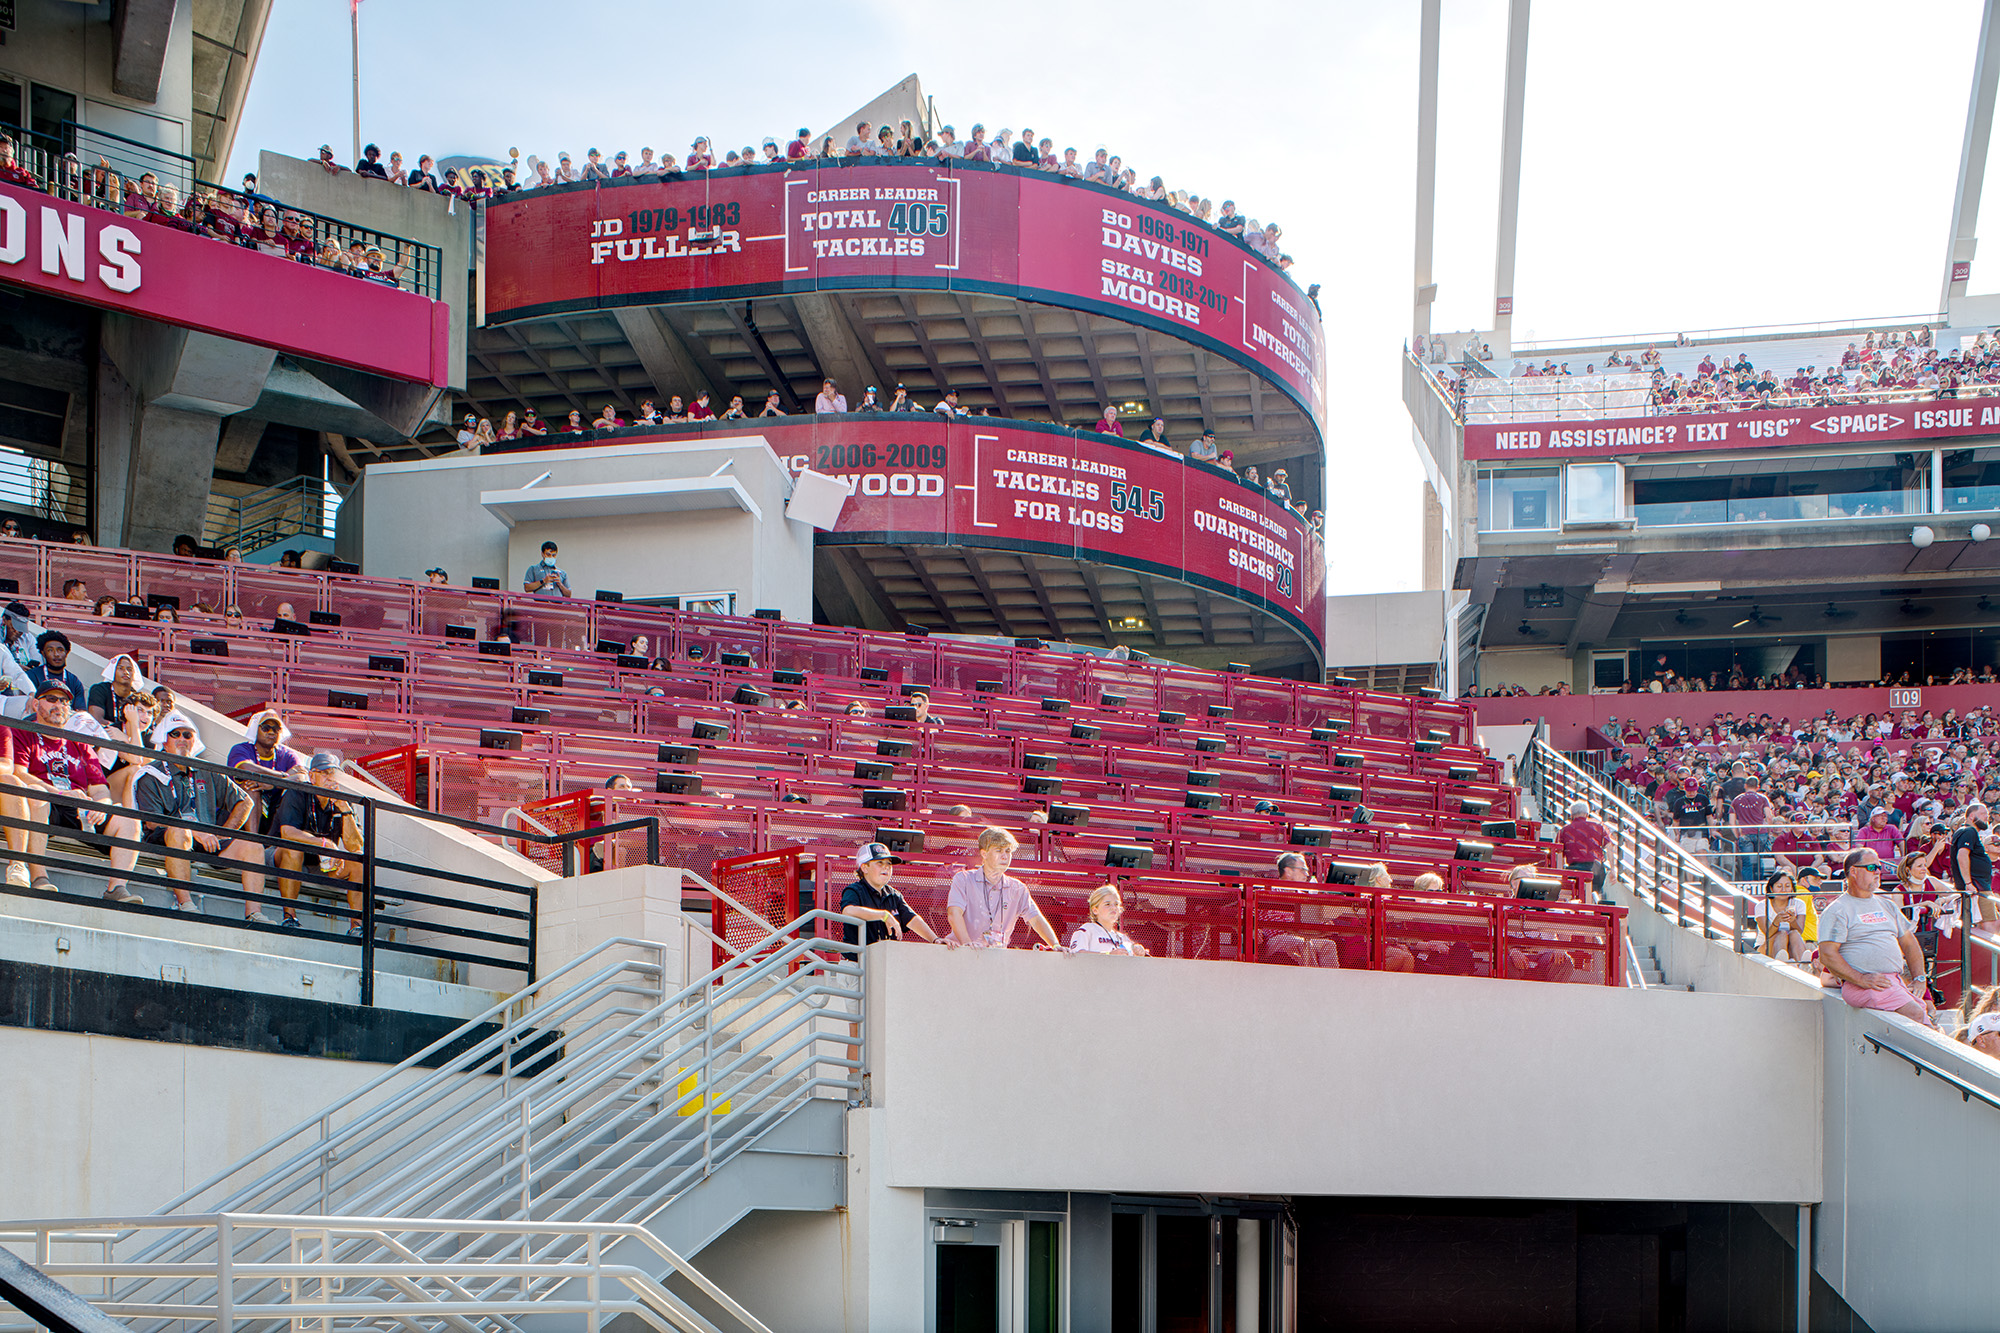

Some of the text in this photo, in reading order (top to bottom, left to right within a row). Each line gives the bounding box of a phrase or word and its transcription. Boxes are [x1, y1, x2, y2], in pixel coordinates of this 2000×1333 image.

[807, 187, 938, 203] CAREER LEADER
[591, 201, 741, 238] JD 1979-1983
[801, 202, 949, 237] TOTAL 405
[1102, 208, 1209, 258] BO 1969-1971
[813, 237, 925, 258] TACKLES
[1102, 226, 1203, 277] DAVIES
[1101, 258, 1228, 315] SKAI 2013-2017
[1101, 276, 1200, 325] MOORE
[1271, 290, 1299, 322] CAREER
[1282, 318, 1312, 361] TOTAL
[1495, 431, 1541, 450] NEED
[1548, 425, 1677, 448] ASSISTANCE?
[1685, 422, 1729, 442] TEXT
[1810, 413, 1905, 434] <SPACE>
[1914, 408, 1973, 430] ISSUE
[780, 443, 947, 472] IC 2006-2009
[1007, 449, 1127, 480] CAREER LEADER
[993, 469, 1165, 523] TACKLES 54.5
[1014, 499, 1124, 534] FOR LOSS
[1218, 497, 1288, 540] CAREER LEADER
[1194, 509, 1295, 571] QUARTERBACK
[1228, 548, 1292, 599] SACKS 29
[1894, 690, 1919, 705] 109
